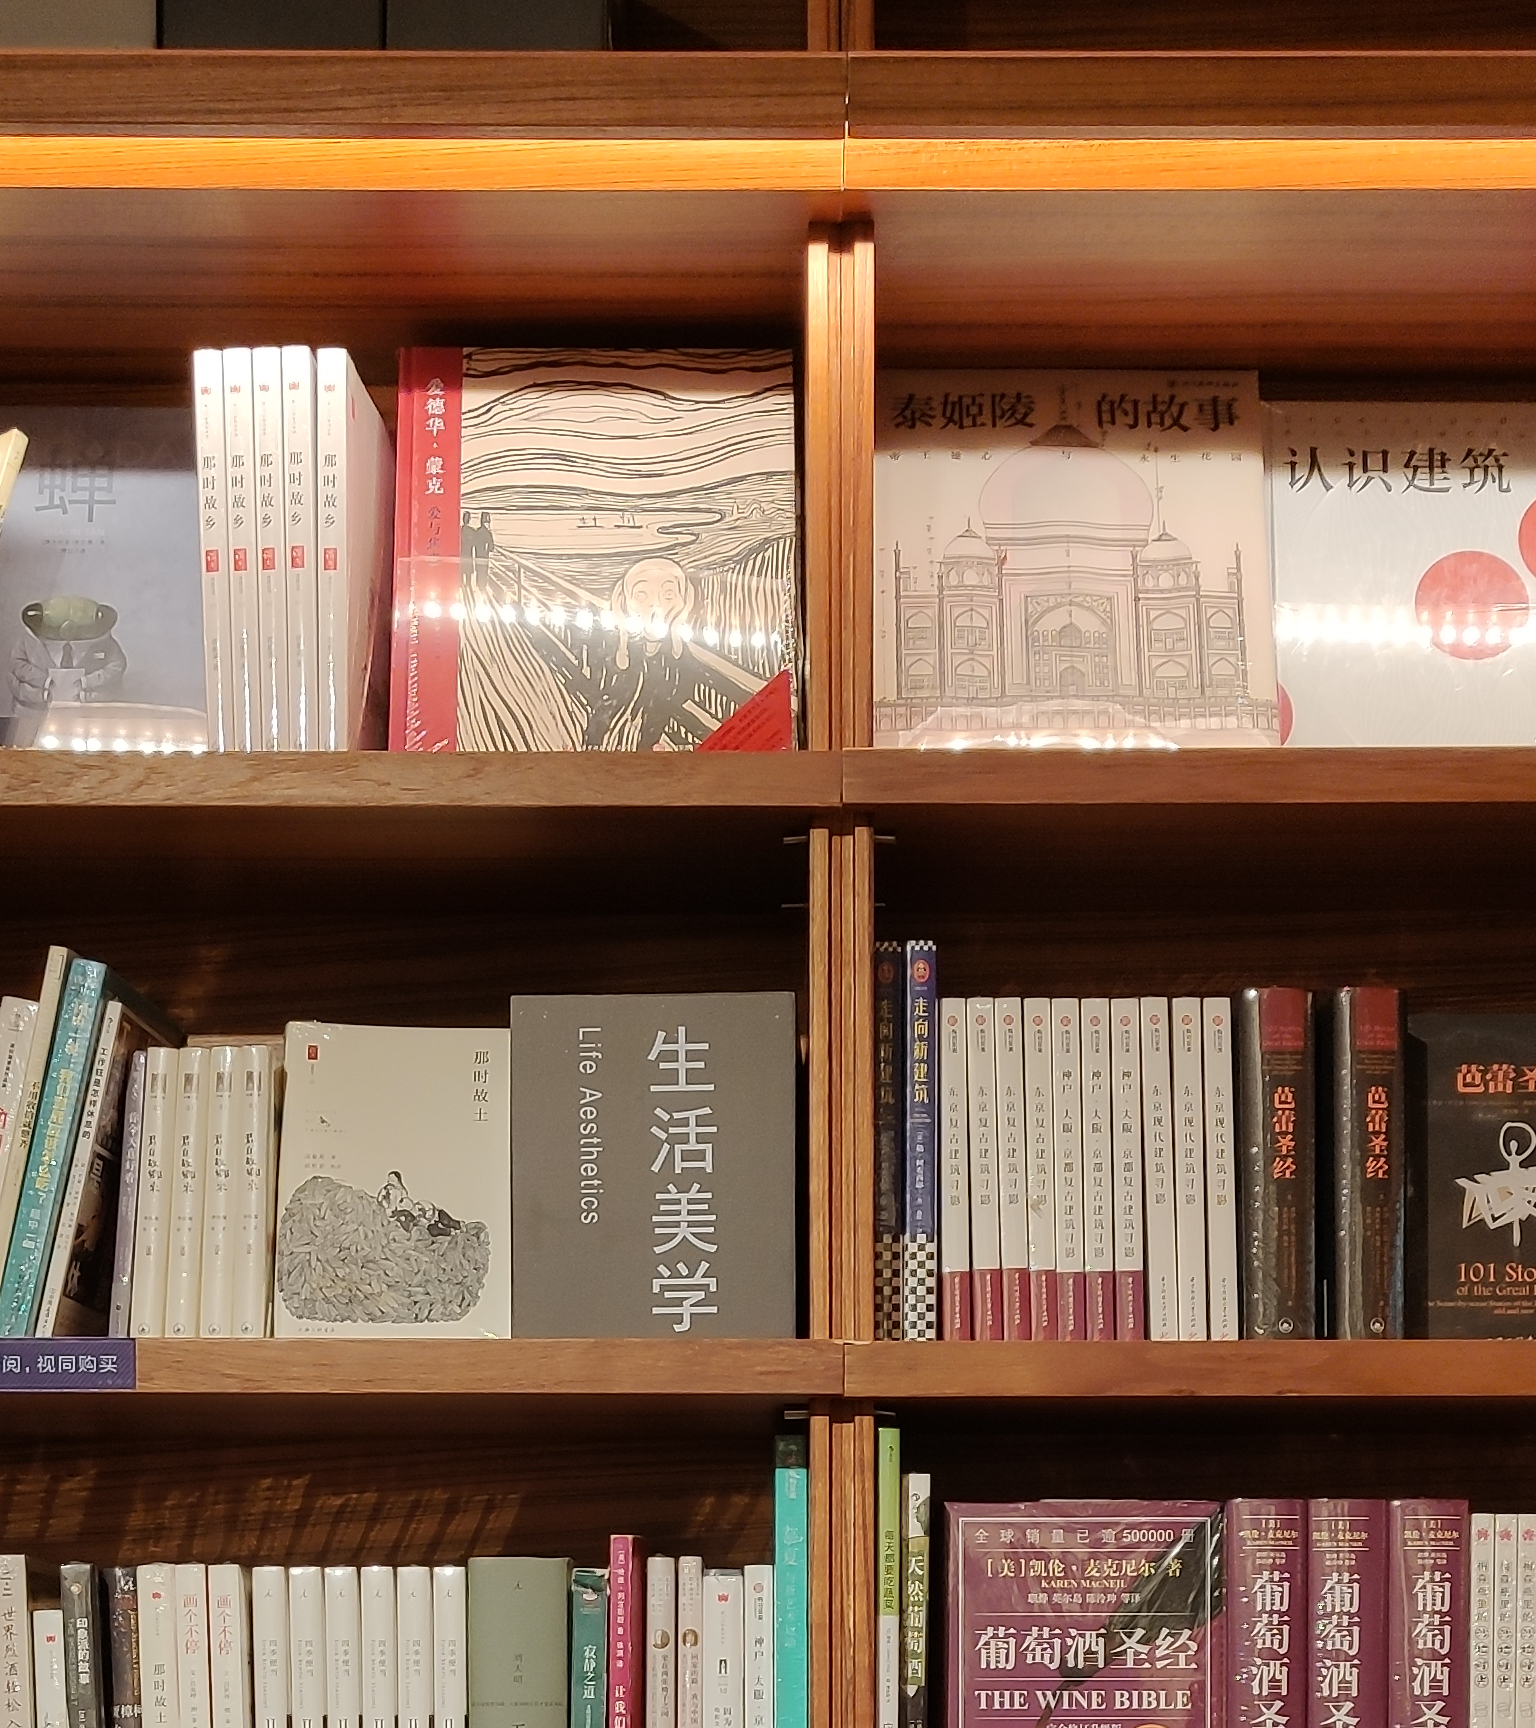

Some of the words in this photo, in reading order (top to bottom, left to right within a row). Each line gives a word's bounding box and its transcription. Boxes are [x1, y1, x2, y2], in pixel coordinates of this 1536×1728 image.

[424, 376, 446, 496] 爱德华·蒙克
[892, 390, 1036, 430] 泰姬陵
[1096, 391, 1241, 430] 的故事
[202, 454, 218, 531] 那时故乡
[231, 454, 247, 530] 那时故乡
[260, 452, 275, 530] 那时故乡
[288, 450, 305, 528] 那时故乡
[322, 454, 339, 529] 那时故乡
[1283, 445, 1513, 495] 认识建筑
[472, 1050, 490, 1124] 那时故土
[578, 1027, 602, 1075] Life
[912, 996, 930, 1104] 走向新建筑
[578, 1086, 604, 1225] Aesthetics
[948, 1085, 962, 1207] 东京复古建筑寻影
[977, 1085, 991, 1207] 东京复古建筑寻影
[1151, 1084, 1167, 1206] 东京现代建筑寻影
[1182, 1085, 1197, 1206] 东京现代建筑寻影
[1273, 1085, 1297, 1181] 芭蕾圣经
[1365, 1085, 1390, 1180] 芭蕾圣经
[648, 1025, 718, 1333] 生活美学
[1456, 1284, 1470, 1296] of
[1473, 1284, 1492, 1296] the
[1496, 1284, 1531, 1296] Great
[1457, 1263, 1497, 1283] 101
[183, 1594, 199, 1656] 画个不停
[217, 1594, 234, 1656] 画个不停
[974, 1626, 1199, 1671] 葡萄酒圣经
[153, 1663, 168, 1725] 那时故土
[582, 1643, 596, 1699] 寂静之道
[976, 1690, 1026, 1711] THE
[1034, 1690, 1107, 1711] WINE
[1116, 1690, 1192, 1711] BIBLE
